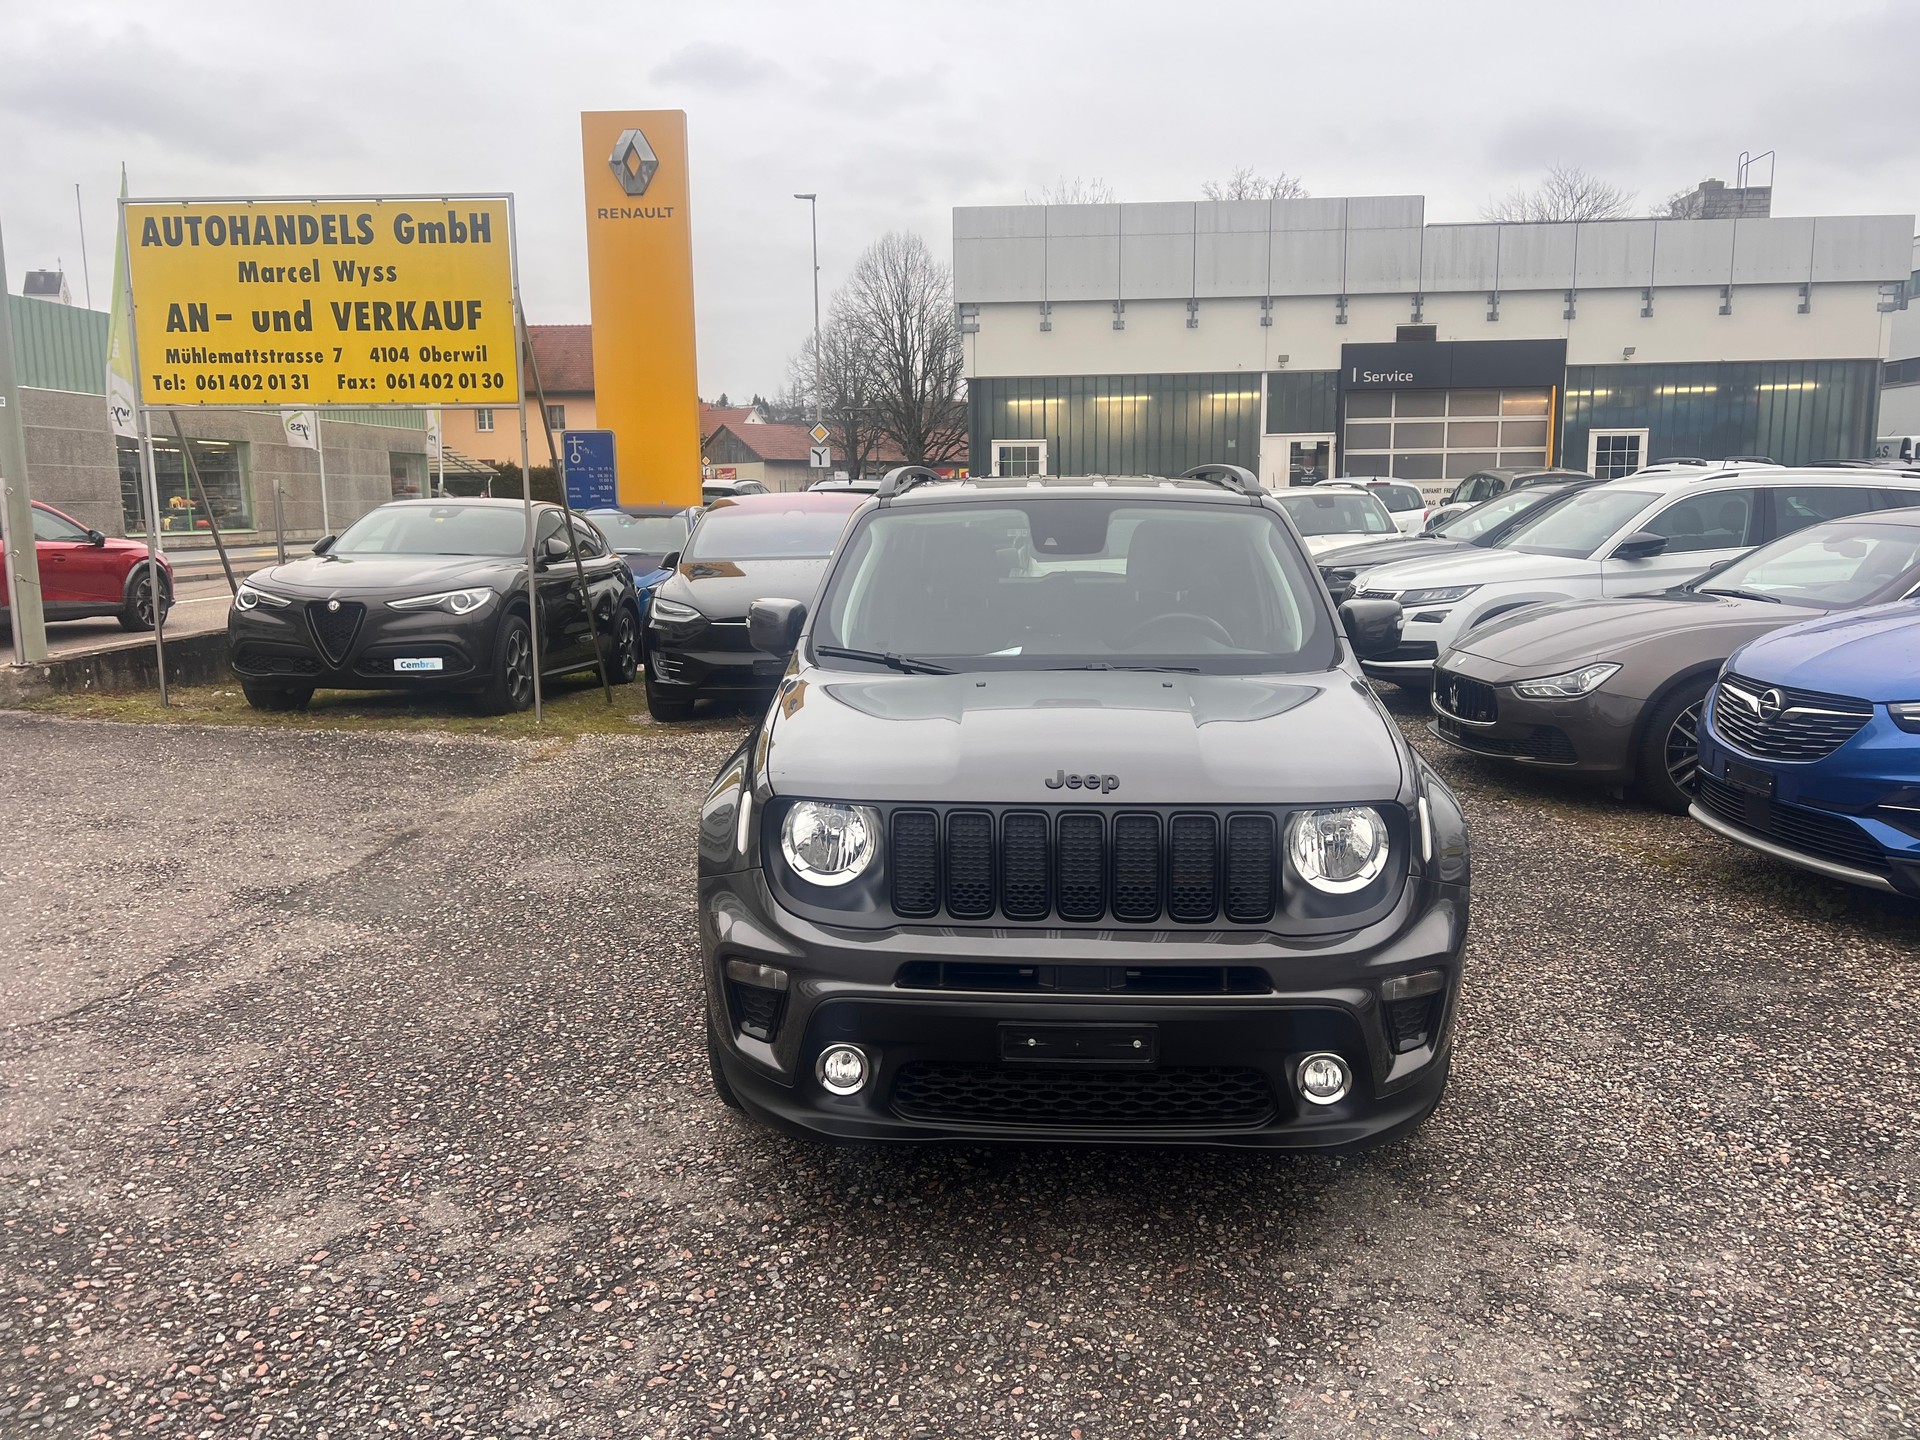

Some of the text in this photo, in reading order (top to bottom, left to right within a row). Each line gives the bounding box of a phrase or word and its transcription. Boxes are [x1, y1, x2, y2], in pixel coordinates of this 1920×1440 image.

[597, 207, 674, 219] RENAULT
[141, 210, 491, 247] AUTOHANDELS GmbH
[238, 258, 397, 287] Marcel Wyss
[251, 299, 313, 333] und
[330, 300, 482, 332] VERKAUF
[165, 345, 488, 364] Mühlemattstrasse 7 4104 Oberwil
[152, 374, 186, 391] Tel:
[337, 373, 376, 390] Fax:
[1363, 370, 1414, 382] Service
[400, 660, 436, 668] Cembra
[1044, 769, 1120, 795] Jeep
